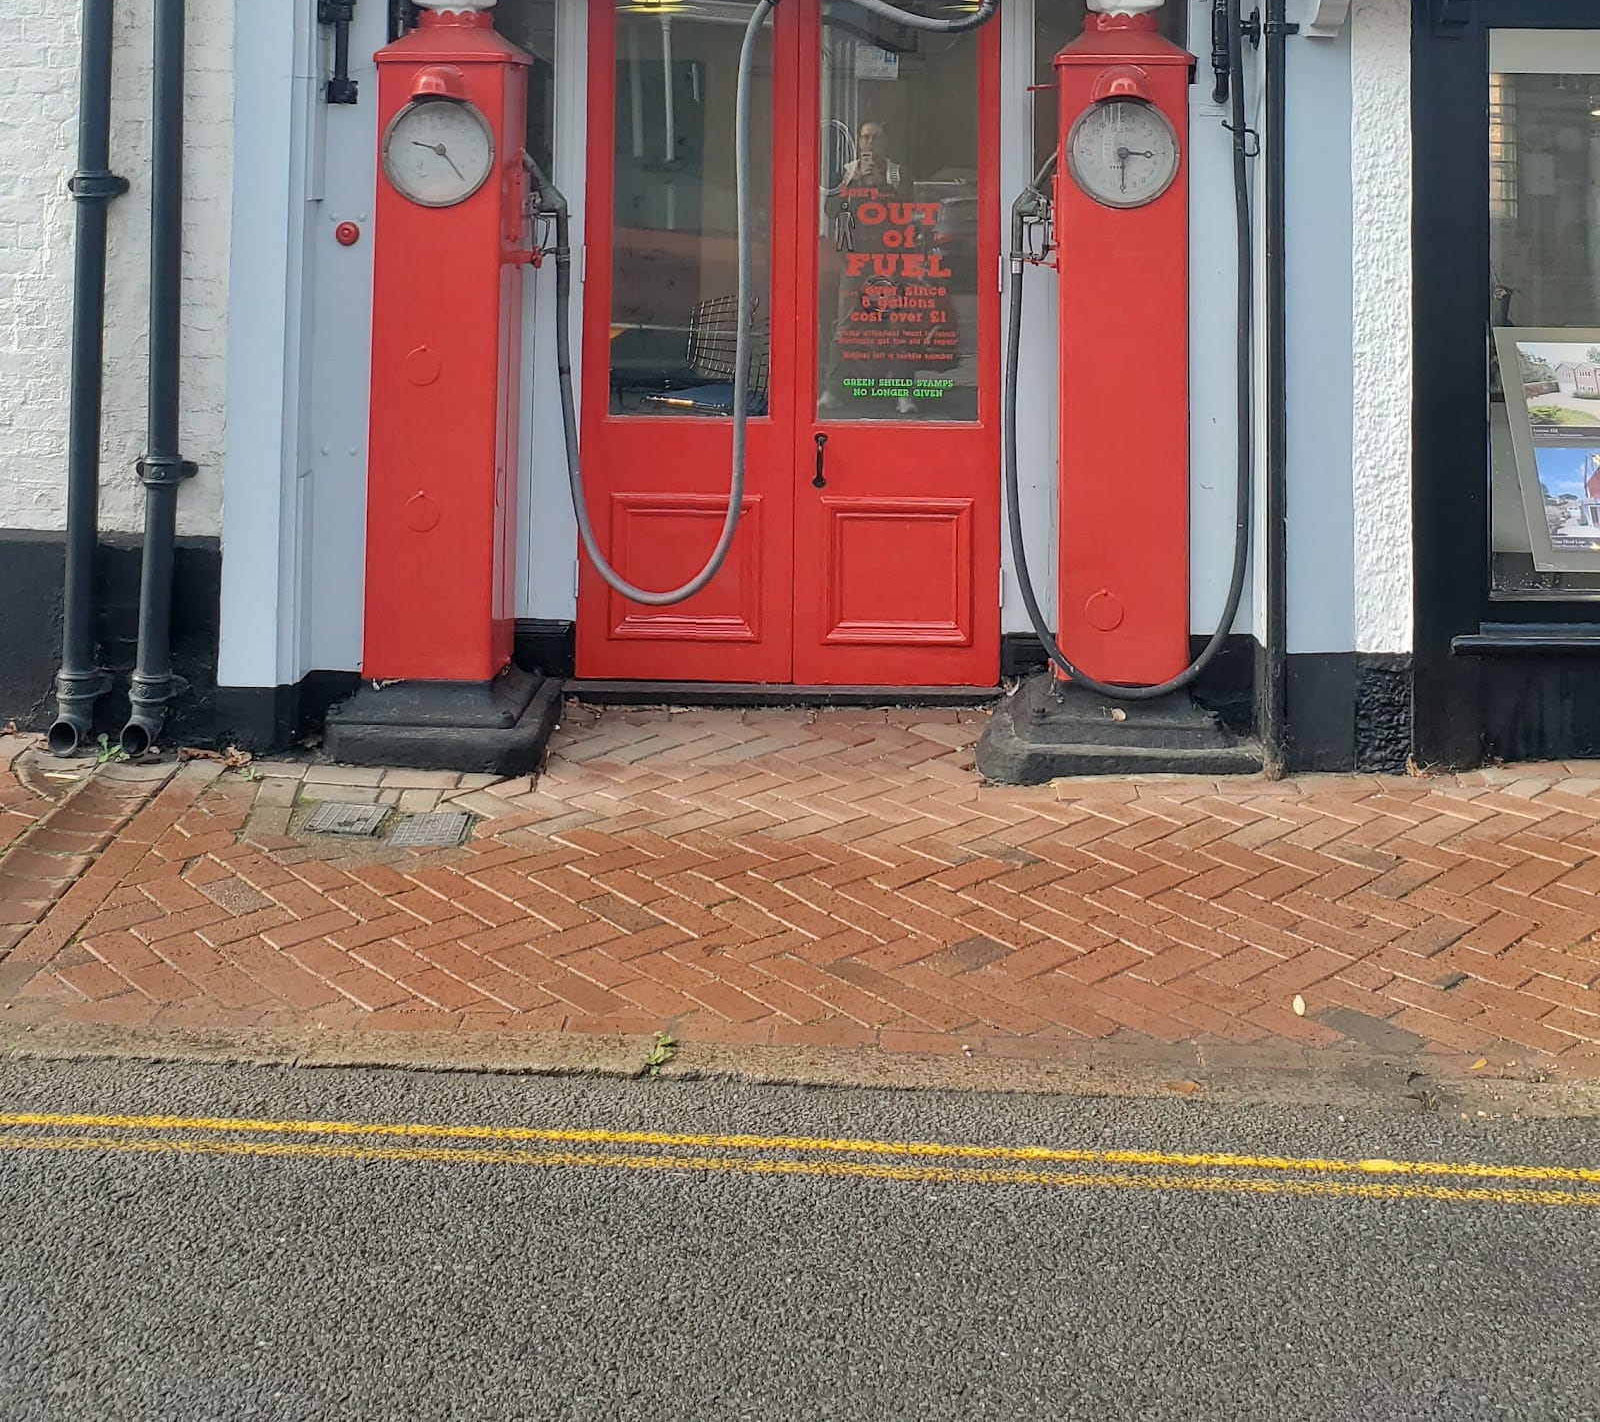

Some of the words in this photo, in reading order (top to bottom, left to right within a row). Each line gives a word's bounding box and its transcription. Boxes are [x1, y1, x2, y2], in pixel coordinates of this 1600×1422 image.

[856, 202, 941, 226] OUT
[882, 225, 915, 248] of
[845, 253, 952, 277] FUEL
[904, 285, 946, 296] since
[878, 296, 935, 309] gallons
[851, 310, 883, 323] cost
[889, 312, 922, 323] over
[879, 379, 912, 387] SHIELD
[917, 379, 954, 388] STAMPS
[871, 389, 909, 397] LONGER
